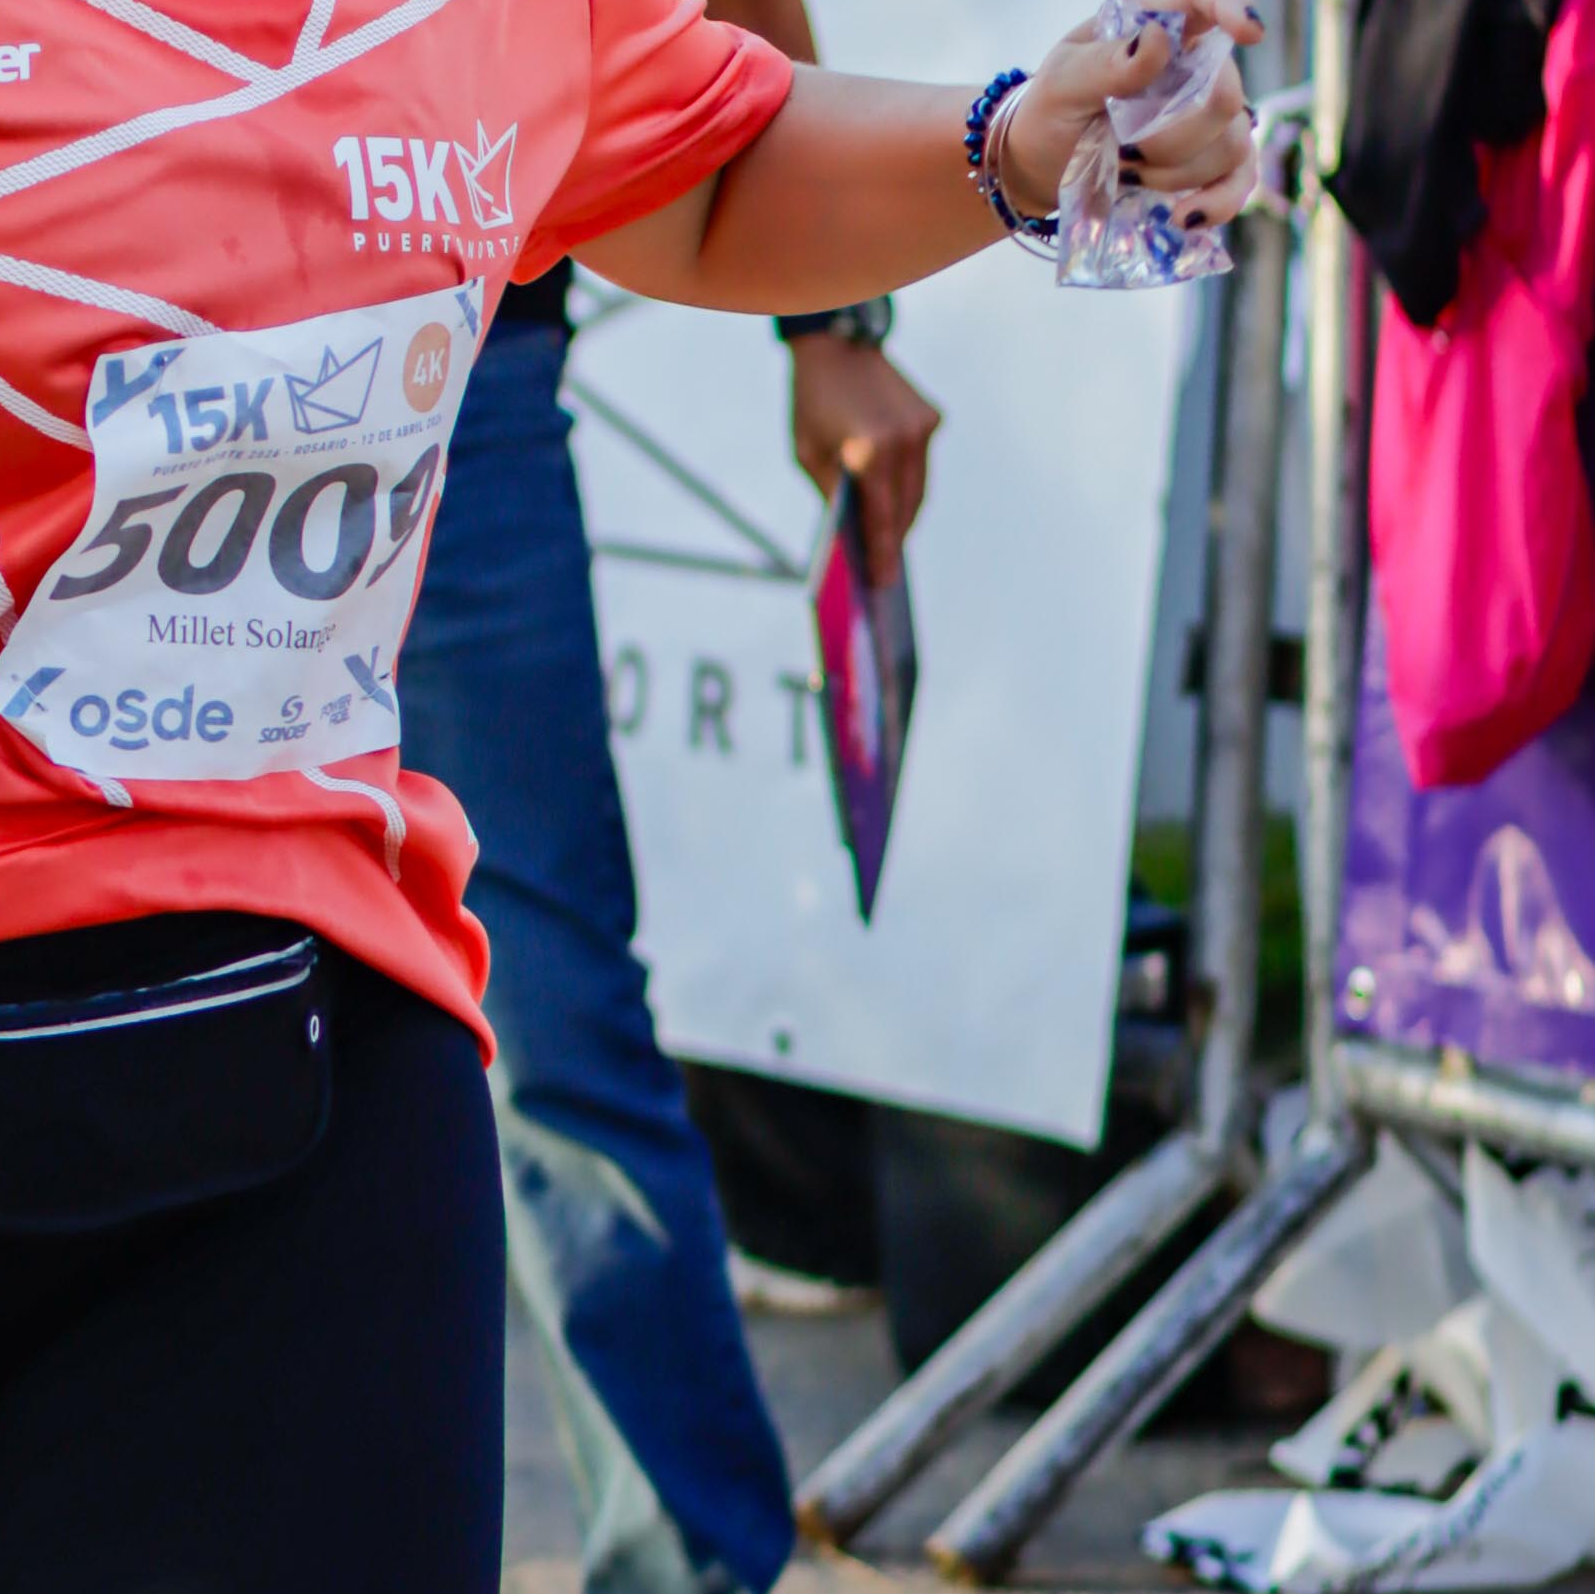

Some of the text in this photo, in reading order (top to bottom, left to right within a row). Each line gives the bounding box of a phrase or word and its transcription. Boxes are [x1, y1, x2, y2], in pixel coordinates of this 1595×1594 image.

[333, 136, 462, 225] 15K
[412, 348, 447, 386] 4K
[147, 377, 275, 455] 15K
[293, 438, 348, 455] ROSARIO
[361, 434, 375, 445] 12
[378, 429, 393, 443] DE
[395, 420, 424, 438] ABRIL
[147, 613, 337, 653] Millet Solan
[69, 683, 235, 751] osde
